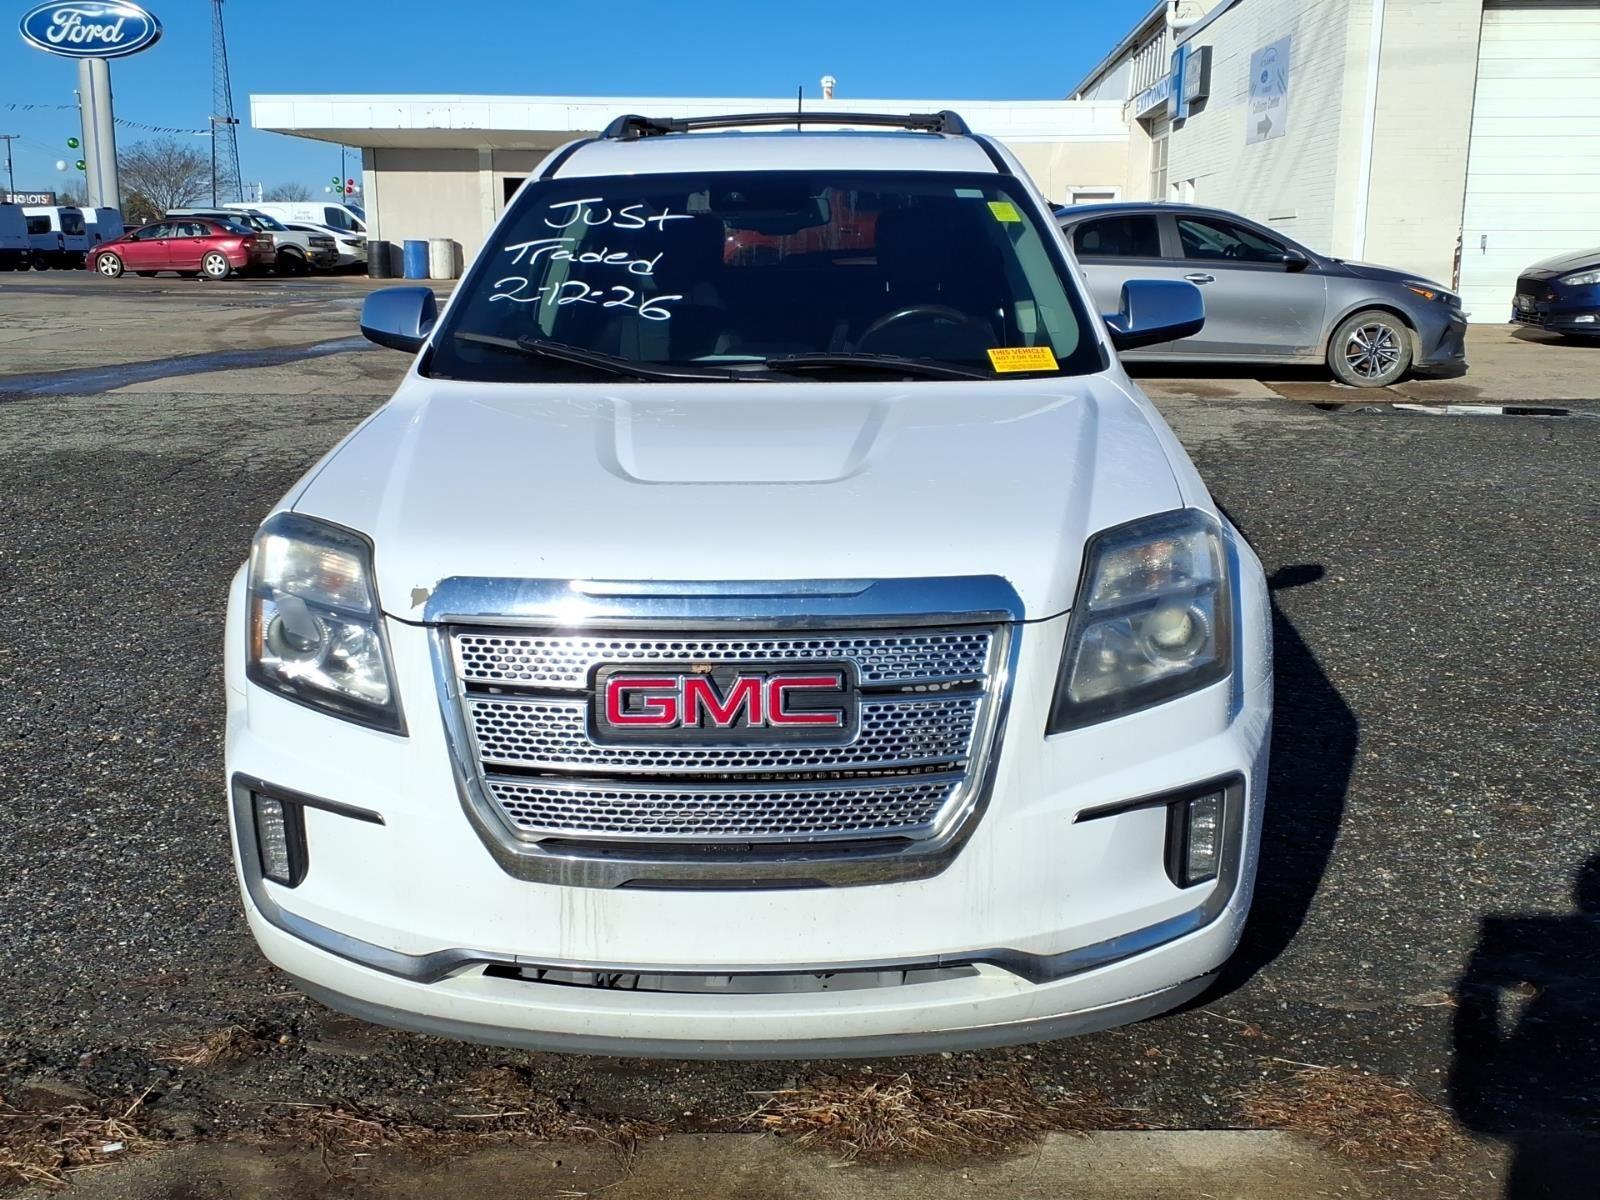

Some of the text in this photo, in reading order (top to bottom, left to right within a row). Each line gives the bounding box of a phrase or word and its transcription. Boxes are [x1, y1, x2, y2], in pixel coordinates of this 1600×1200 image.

[47, 8, 125, 43] Ford
[1136, 89, 1152, 115] EXIT
[1152, 77, 1169, 104] ONLY
[605, 674, 843, 728] GMC
